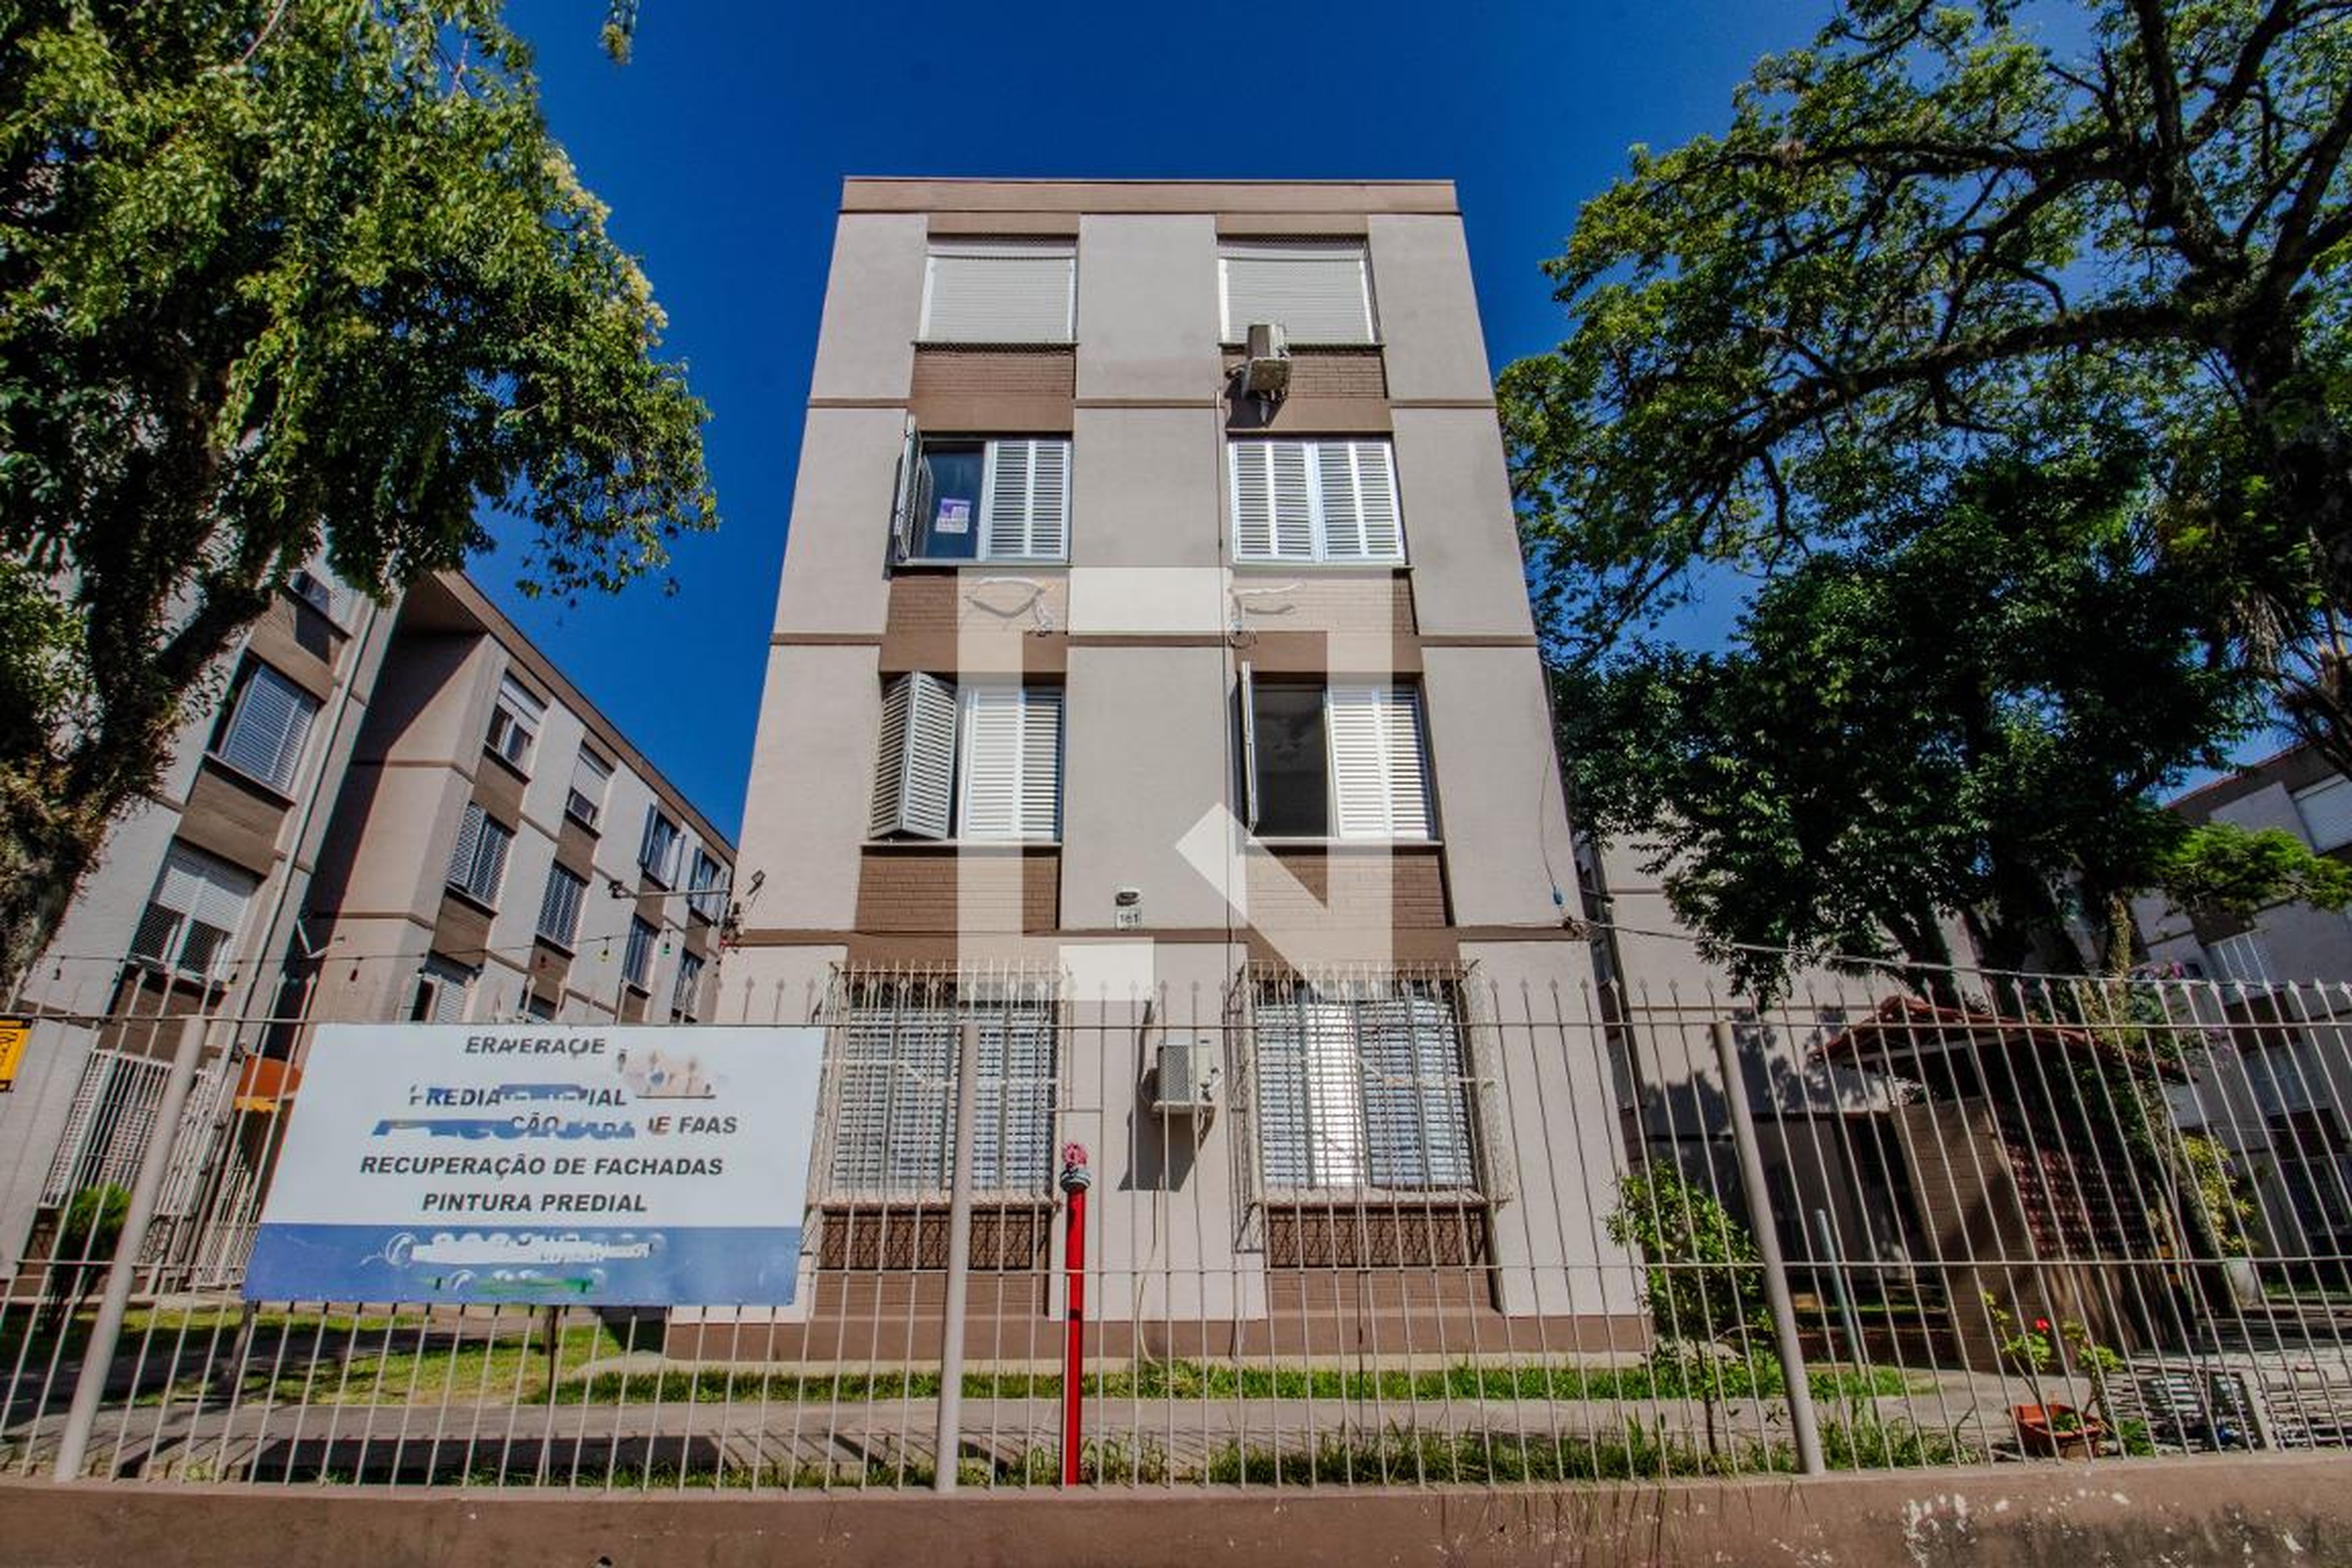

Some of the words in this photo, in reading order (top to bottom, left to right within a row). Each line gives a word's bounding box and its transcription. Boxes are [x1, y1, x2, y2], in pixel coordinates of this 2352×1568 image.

[360, 1153, 545, 1180] RECUPERAÇÃO
[553, 1158, 586, 1175] DE
[594, 1158, 723, 1175] FACHADAS
[422, 1193, 532, 1212] PINTURA
[540, 1194, 647, 1212] PREDIAL
